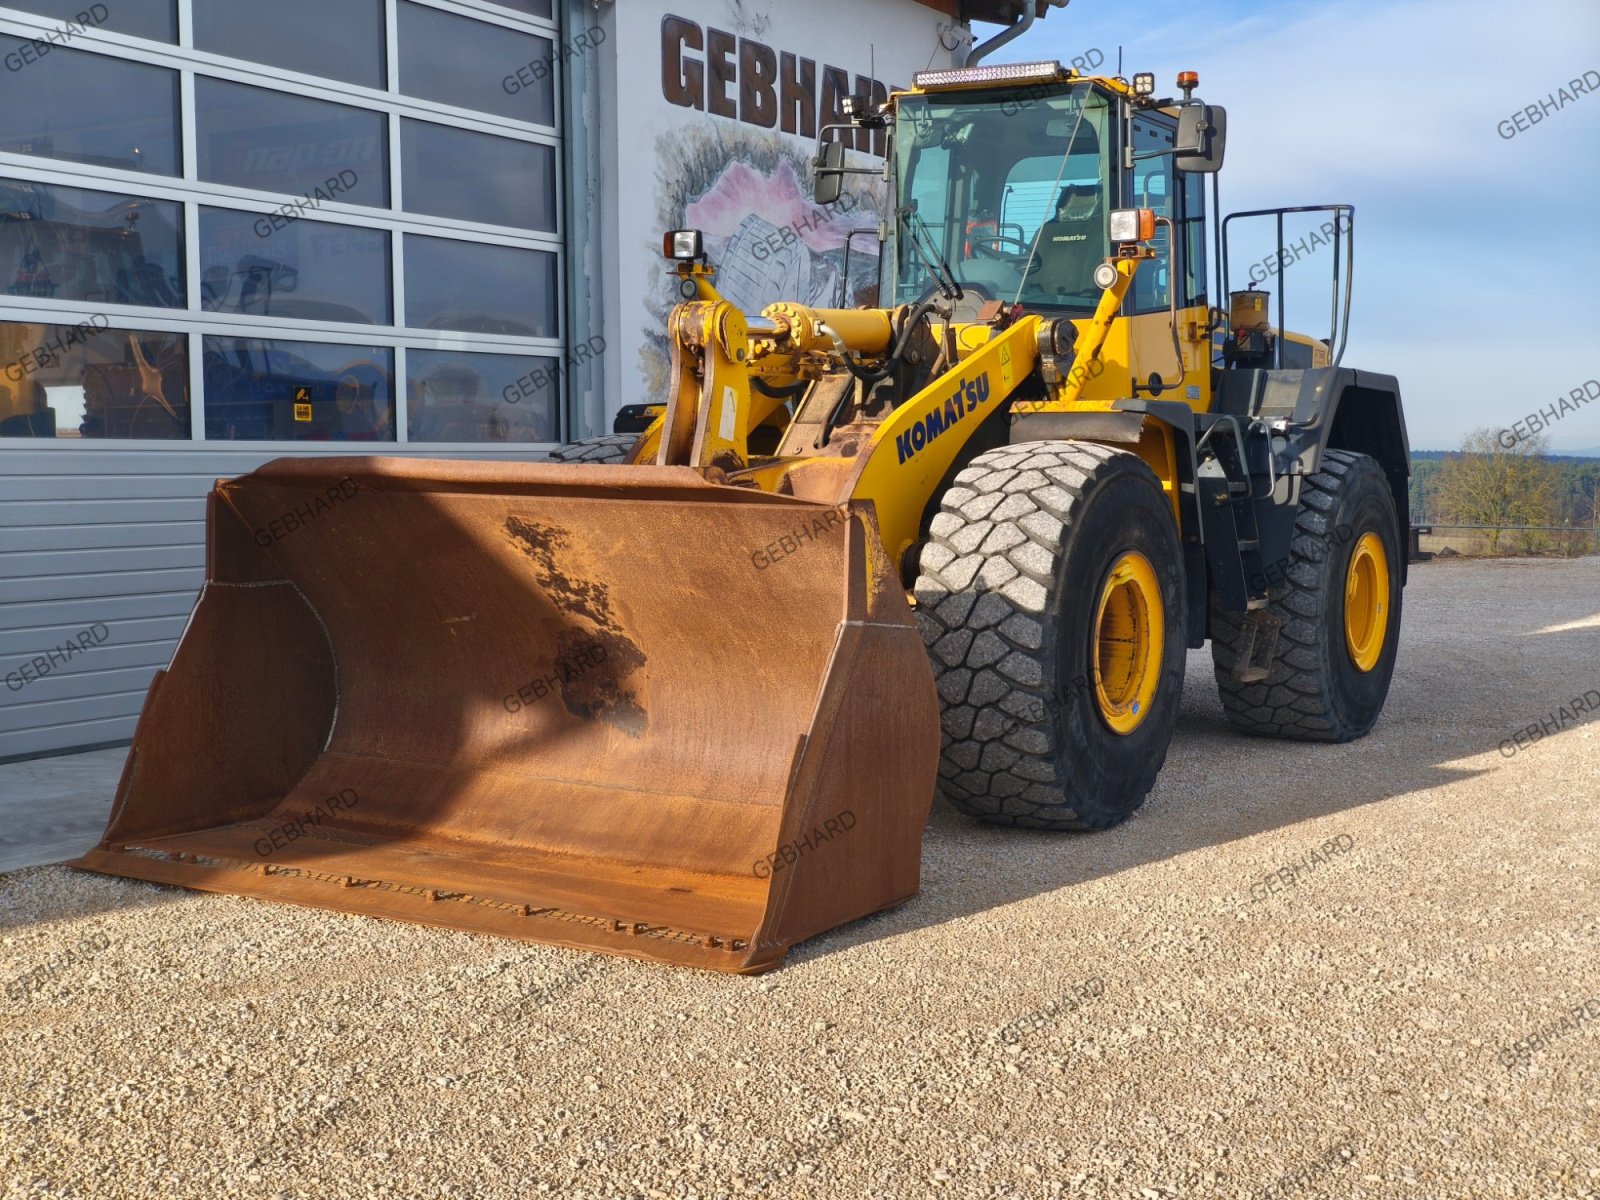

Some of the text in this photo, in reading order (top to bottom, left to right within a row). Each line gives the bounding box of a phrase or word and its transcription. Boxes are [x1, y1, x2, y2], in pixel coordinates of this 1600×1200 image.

[661, 13, 908, 157] GEBHAR
[1052, 234, 1087, 242] KOMATSU
[896, 370, 990, 465] KOMATSU
